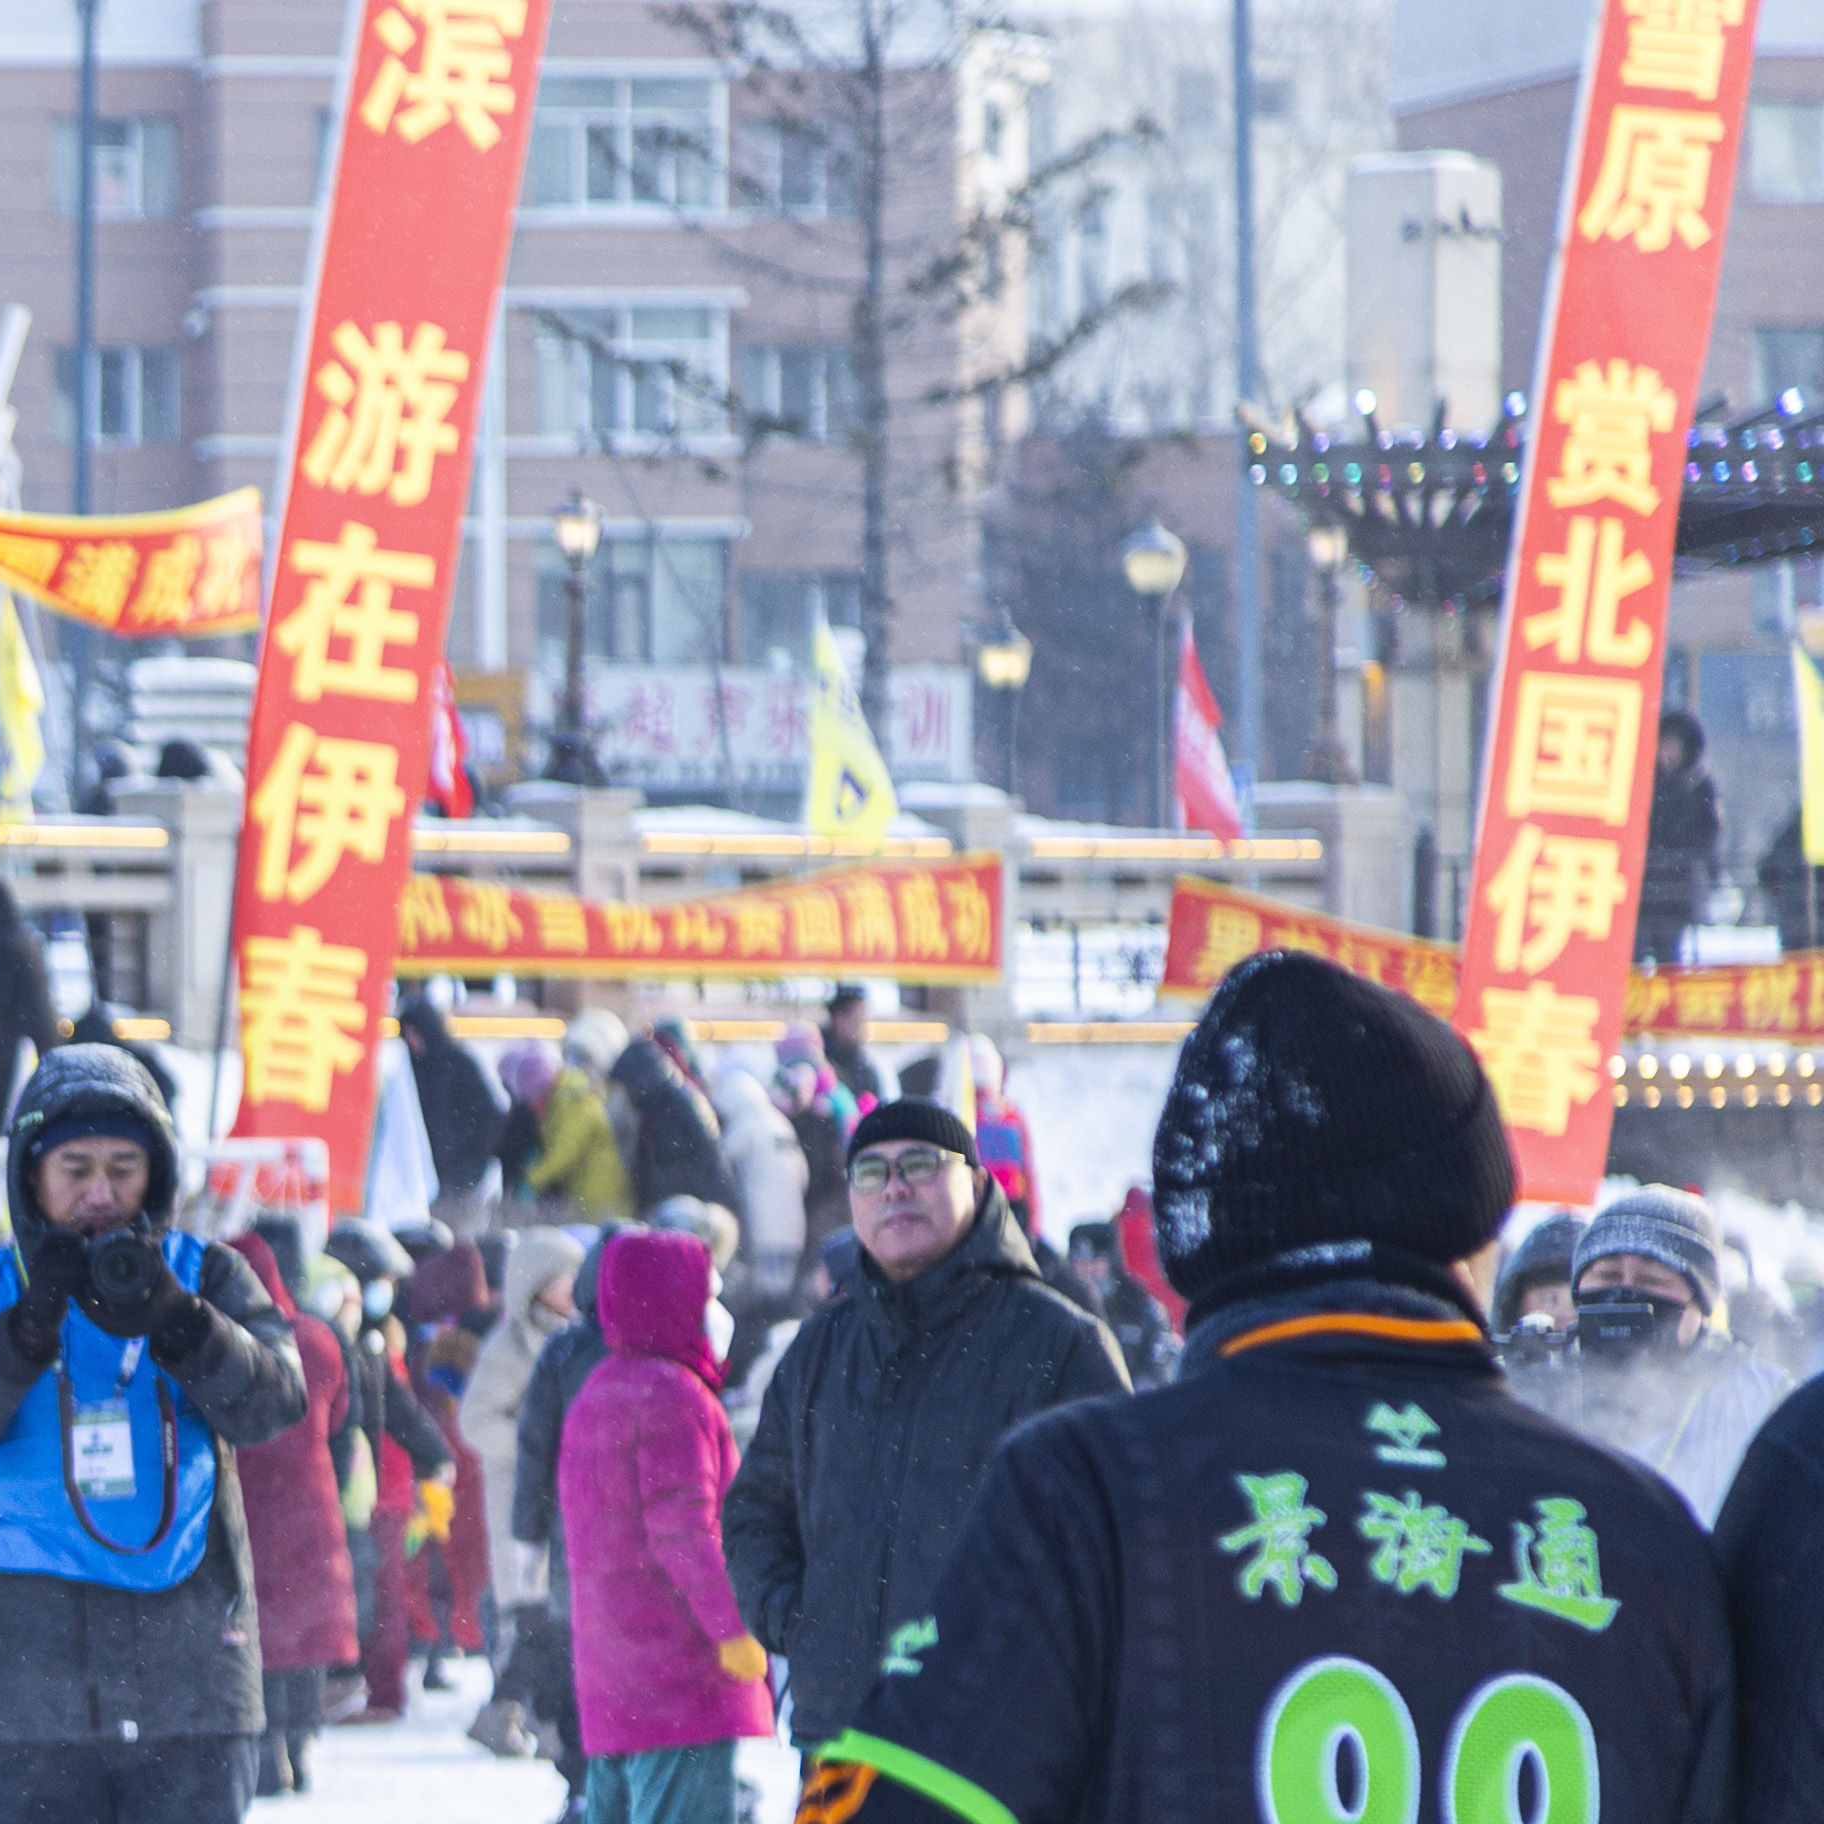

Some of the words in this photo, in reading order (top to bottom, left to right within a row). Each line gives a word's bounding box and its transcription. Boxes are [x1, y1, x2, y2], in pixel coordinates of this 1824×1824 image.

[239, 320, 471, 1113] 游在伊春
[1467, 358, 1678, 1137] 赏北国伊春
